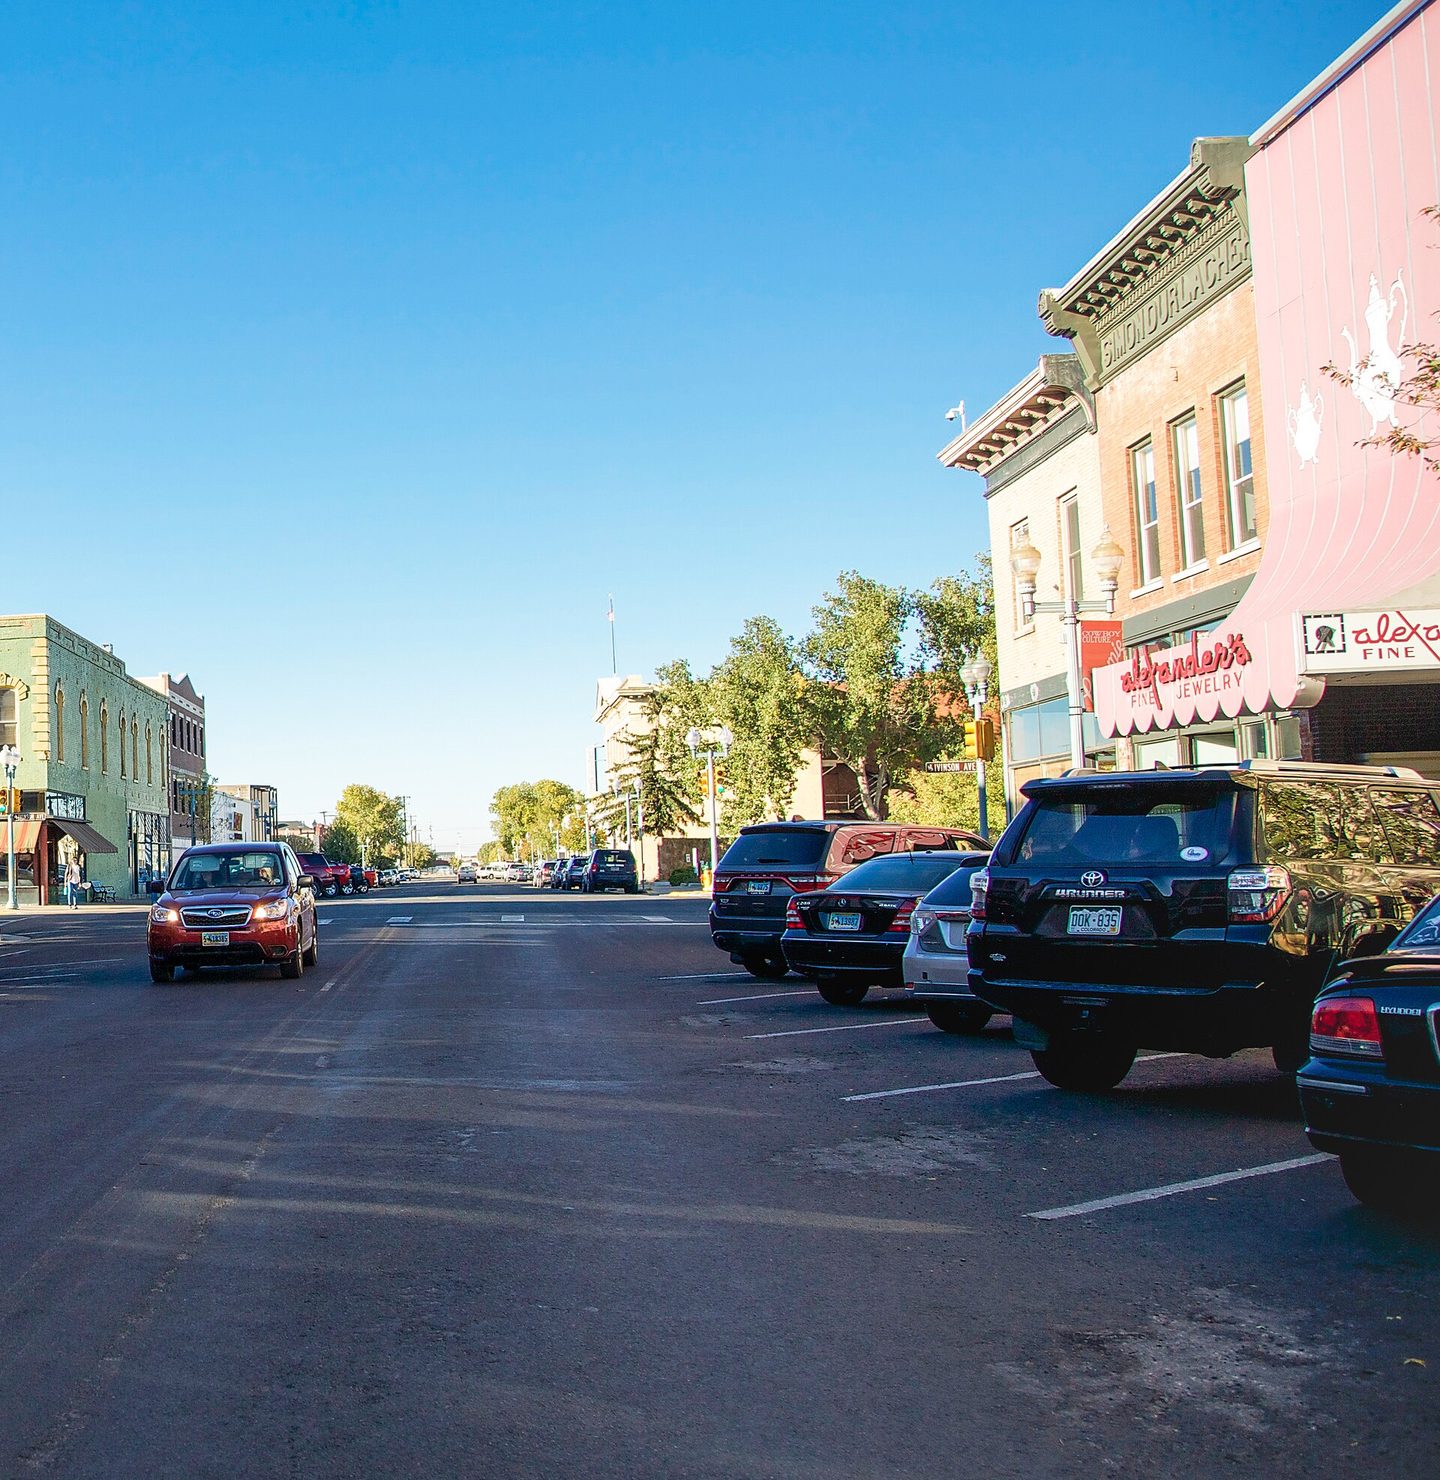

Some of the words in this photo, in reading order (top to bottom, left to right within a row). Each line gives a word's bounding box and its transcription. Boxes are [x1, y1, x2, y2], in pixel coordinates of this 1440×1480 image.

[1103, 308, 1145, 368] SIMON
[1082, 636, 1112, 644] CULTURE
[1363, 646, 1416, 660] FINE
[1121, 630, 1252, 711] alexander's
[1131, 690, 1155, 708] FINE
[1176, 670, 1243, 700] JEWELRY
[934, 762, 960, 772] IVINSON
[963, 762, 976, 771] AVE
[1055, 888, 1126, 898] 4RUNNER
[1380, 1006, 1421, 1016] HYUNDAI
